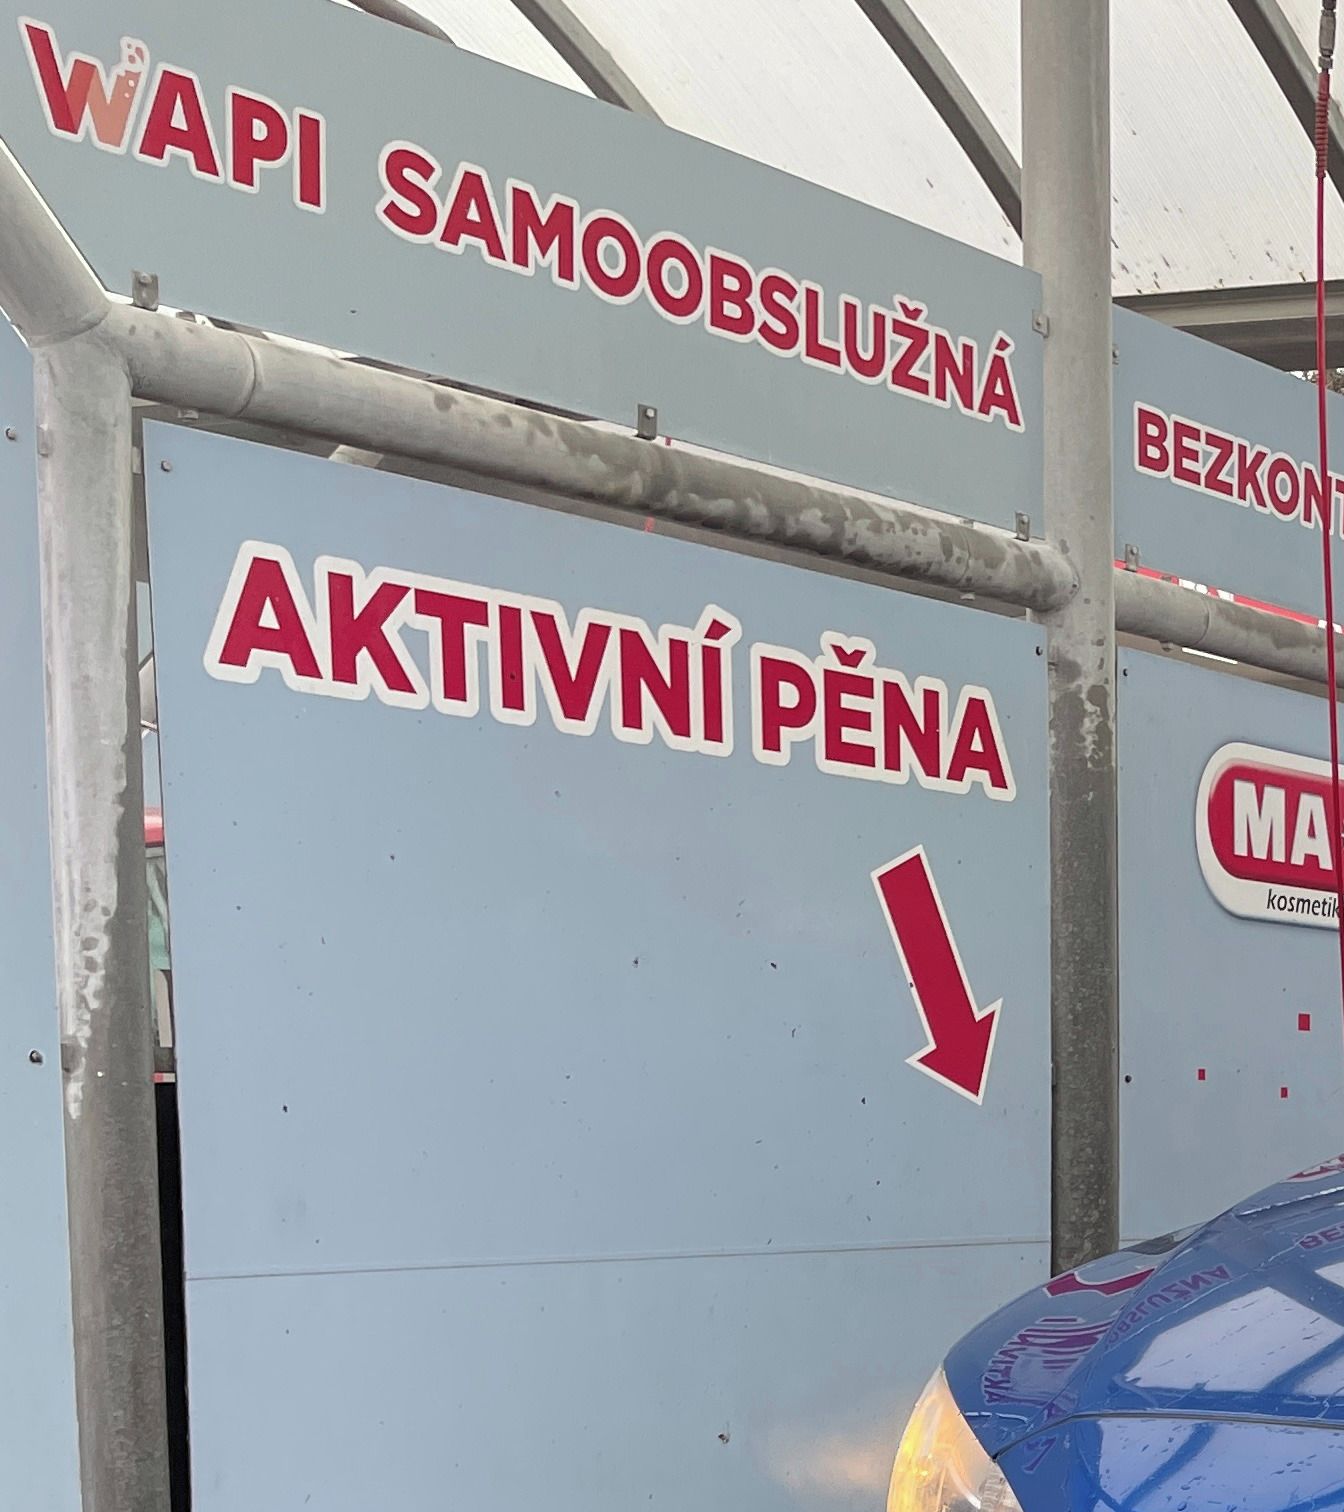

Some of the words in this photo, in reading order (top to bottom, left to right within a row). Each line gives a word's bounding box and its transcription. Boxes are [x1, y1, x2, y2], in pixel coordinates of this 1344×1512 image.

[24, 22, 323, 208] WAPI
[383, 148, 1021, 427] SAMOOBSLUŽNÁ
[219, 556, 734, 744] AKTIVNÍ
[760, 644, 1009, 791] PĚNA
